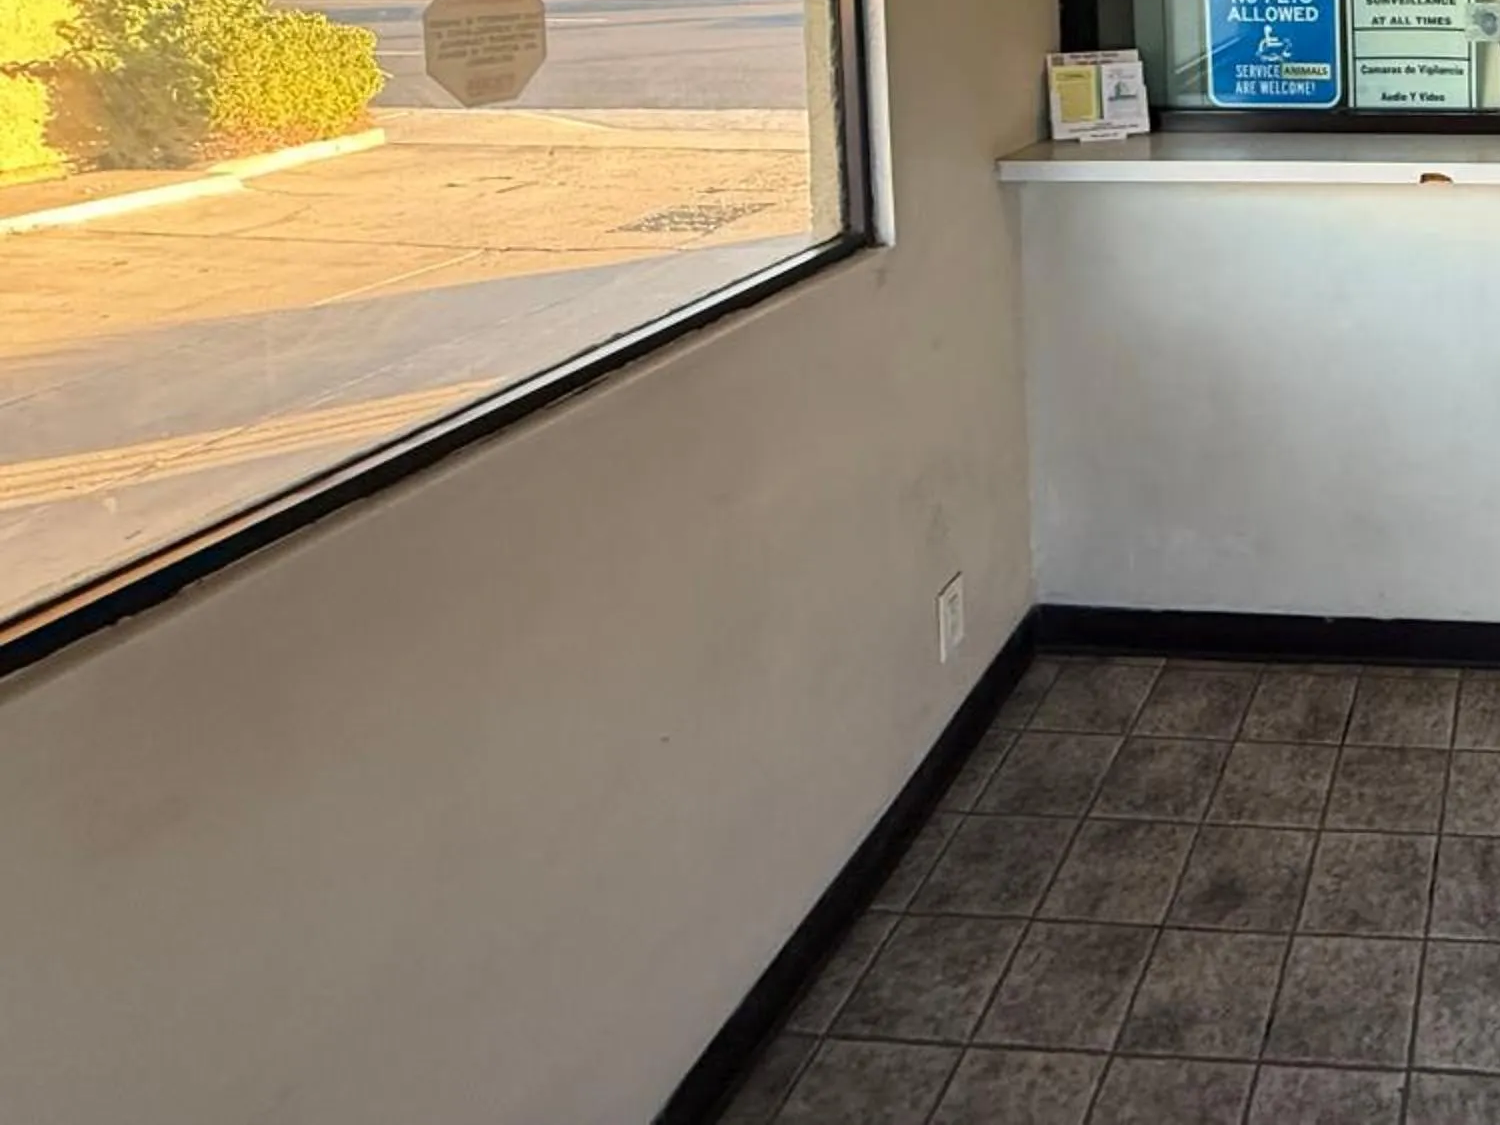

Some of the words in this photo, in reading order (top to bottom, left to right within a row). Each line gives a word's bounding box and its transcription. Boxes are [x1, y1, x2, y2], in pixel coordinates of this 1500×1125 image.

[1227, 6, 1319, 22] ALLOWED
[1371, 16, 1386, 25] AT
[1389, 16, 1412, 25] ALL
[1415, 16, 1453, 25] TIMES
[1235, 64, 1281, 78] SERVICE
[1283, 66, 1329, 76] ANIMALS
[1360, 65, 1402, 74] Camaras
[1405, 65, 1417, 74] de
[1418, 65, 1465, 76] Vigilancia
[1235, 80, 1256, 94] ARE
[1260, 80, 1317, 95] WELCOME!
[1381, 92, 1407, 102] Audio
[1409, 92, 1418, 101] Y
[1419, 92, 1446, 102] Video
